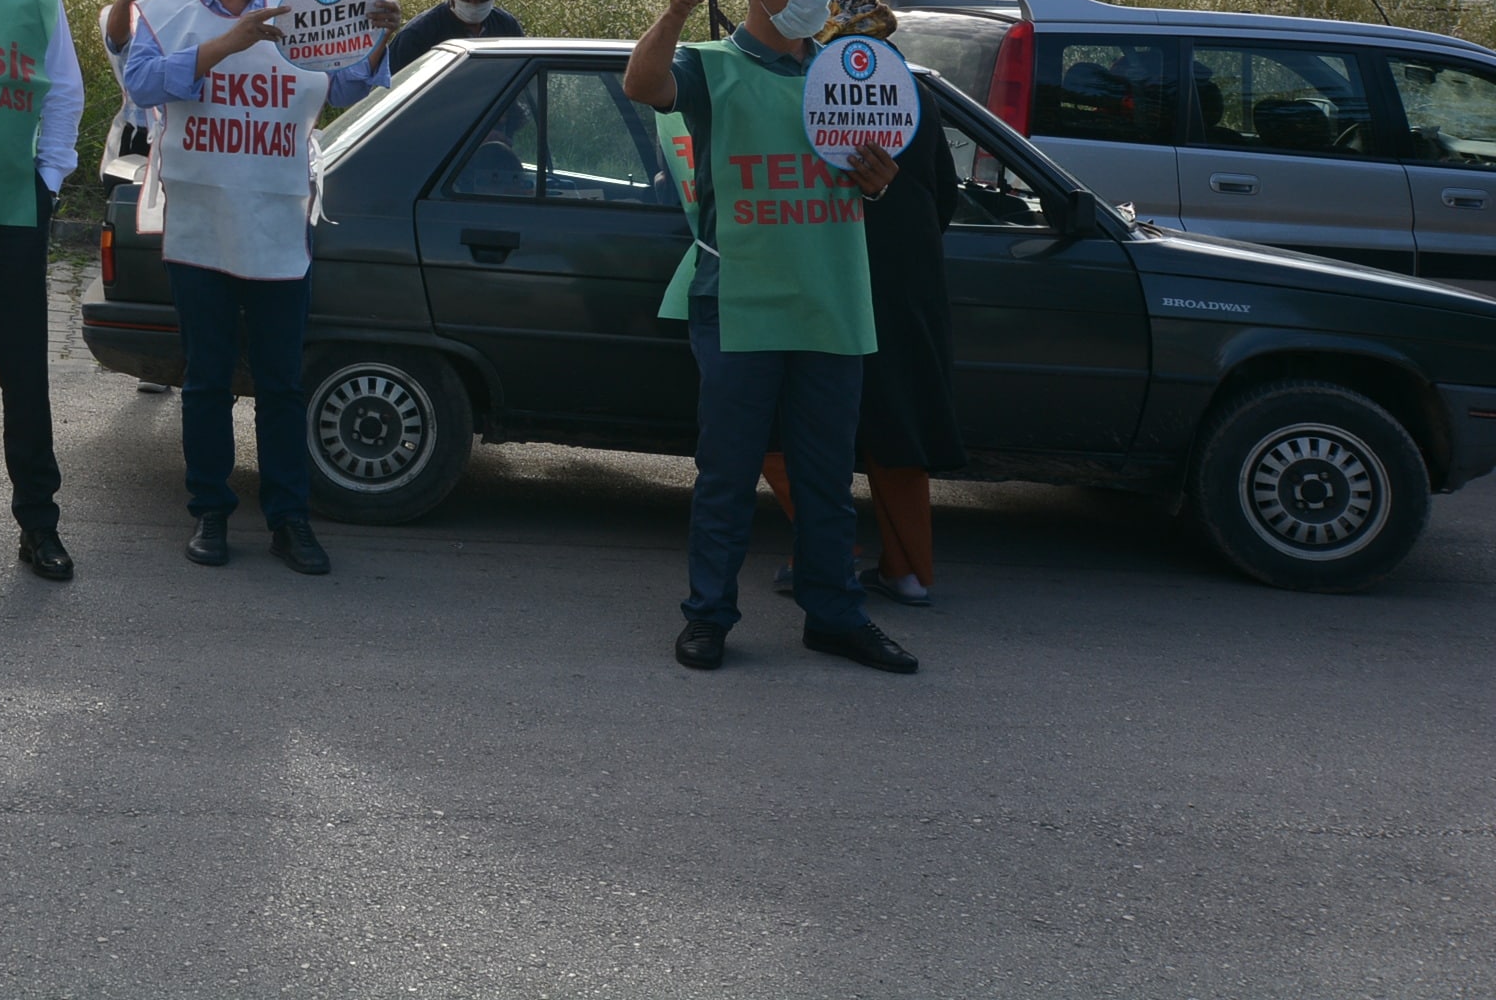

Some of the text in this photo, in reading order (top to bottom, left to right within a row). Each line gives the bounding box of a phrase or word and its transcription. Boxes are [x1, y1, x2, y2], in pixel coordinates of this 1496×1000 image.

[294, 1, 366, 29] KIDEM
[289, 33, 373, 60] DOKUNMA
[824, 83, 898, 106] KIDEM
[808, 109, 914, 127] TAZMİNATIMA
[182, 111, 297, 158] SENDİKASI
[815, 129, 903, 148] DOKUNMA
[1161, 297, 1251, 313] BROADWAY
